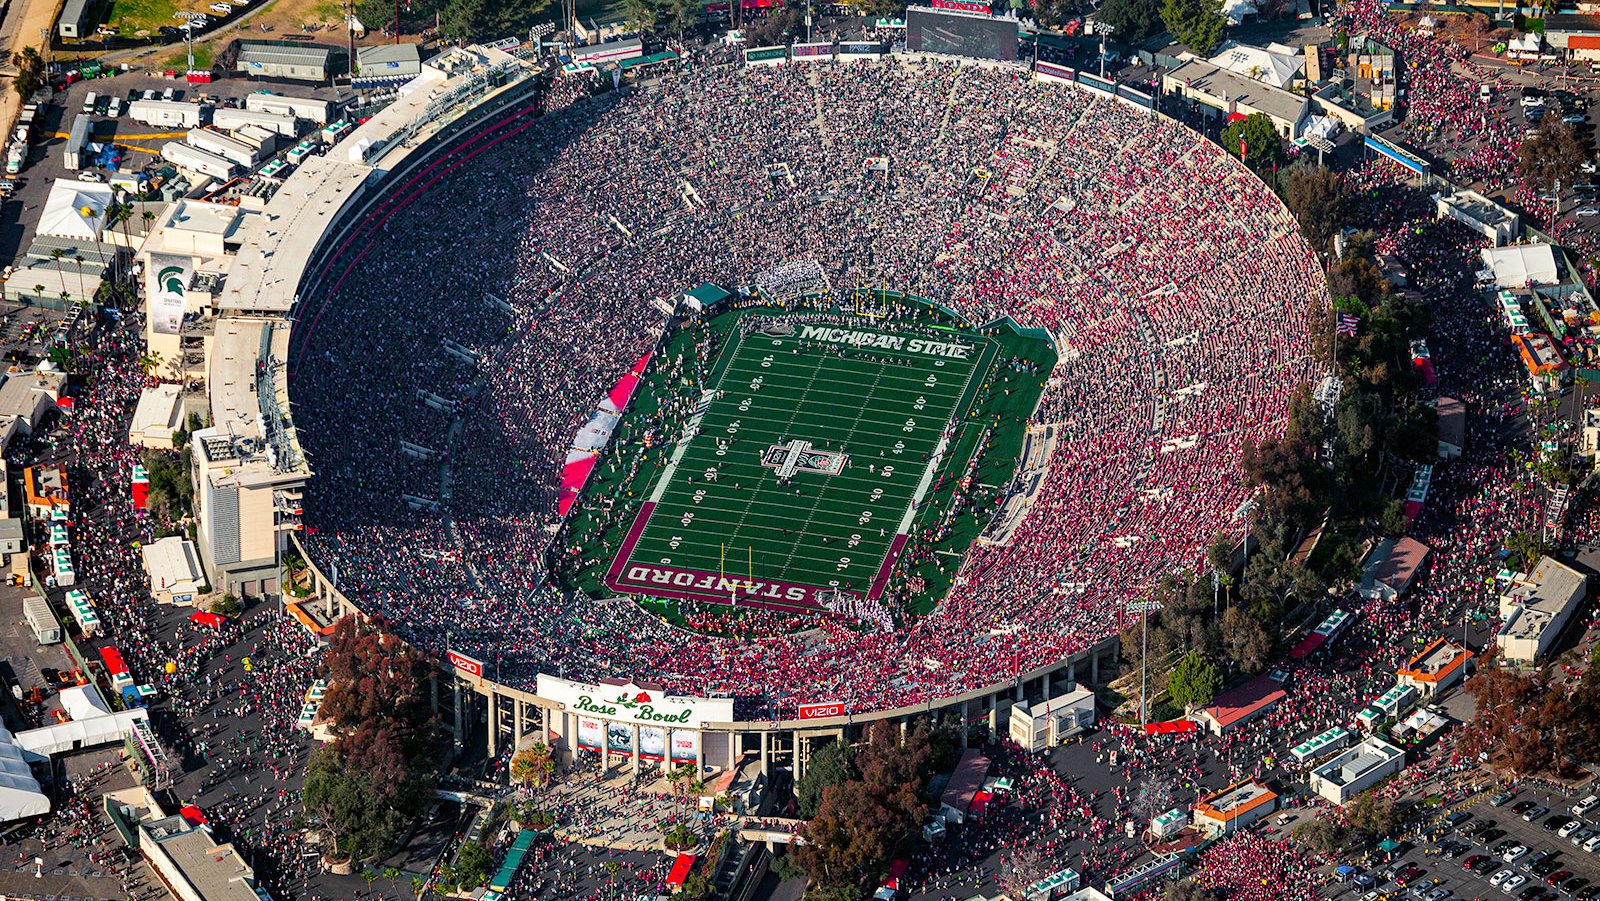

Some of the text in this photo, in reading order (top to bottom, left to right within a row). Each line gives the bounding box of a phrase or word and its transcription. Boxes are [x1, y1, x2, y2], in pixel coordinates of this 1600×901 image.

[932, 0, 992, 14] HONDA
[800, 324, 972, 360] MICHIGAN STATE
[924, 376, 937, 388] 10
[913, 398, 927, 410] 20
[903, 422, 916, 432] 30
[892, 442, 905, 454] 40
[881, 465, 894, 477] 50
[871, 488, 884, 500] 40
[681, 512, 695, 524] 20
[859, 511, 873, 523] 30
[669, 535, 682, 547] 10
[848, 534, 862, 546] 20
[837, 557, 851, 569] 10
[627, 566, 807, 601] STANFORD
[450, 655, 477, 673] VIZIO
[573, 695, 692, 723] Rose Bowl
[805, 706, 839, 717] VIZIO
